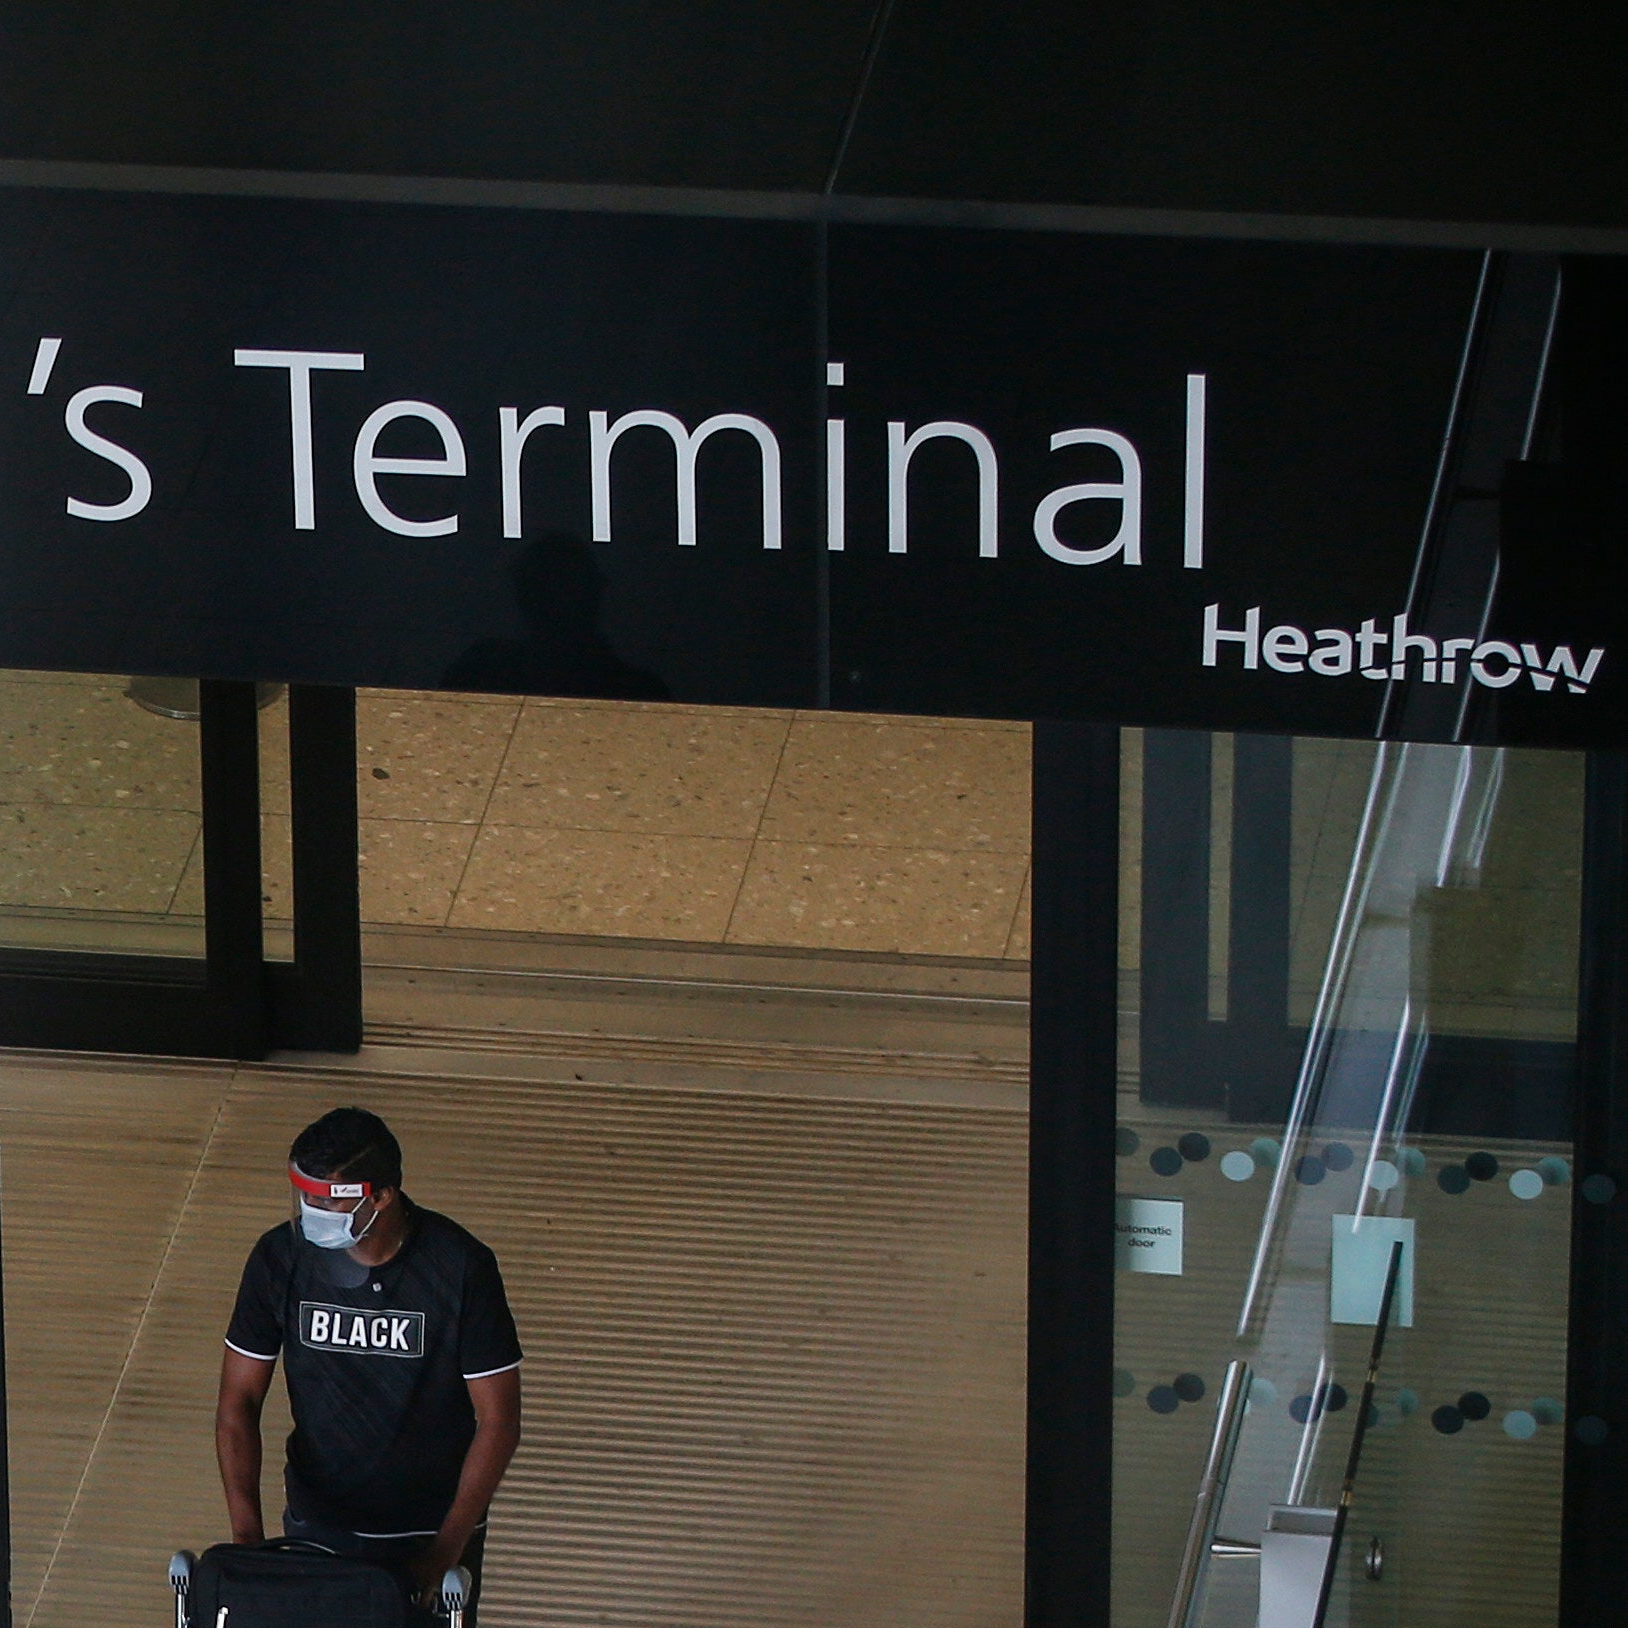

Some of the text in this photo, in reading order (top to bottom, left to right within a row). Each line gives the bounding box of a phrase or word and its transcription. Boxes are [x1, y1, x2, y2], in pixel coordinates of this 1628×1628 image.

[233, 349, 1207, 570] Terminal
[1202, 603, 1605, 694] Heathrow
[1127, 1236, 1157, 1248] door
[309, 1309, 411, 1352] BLACK
